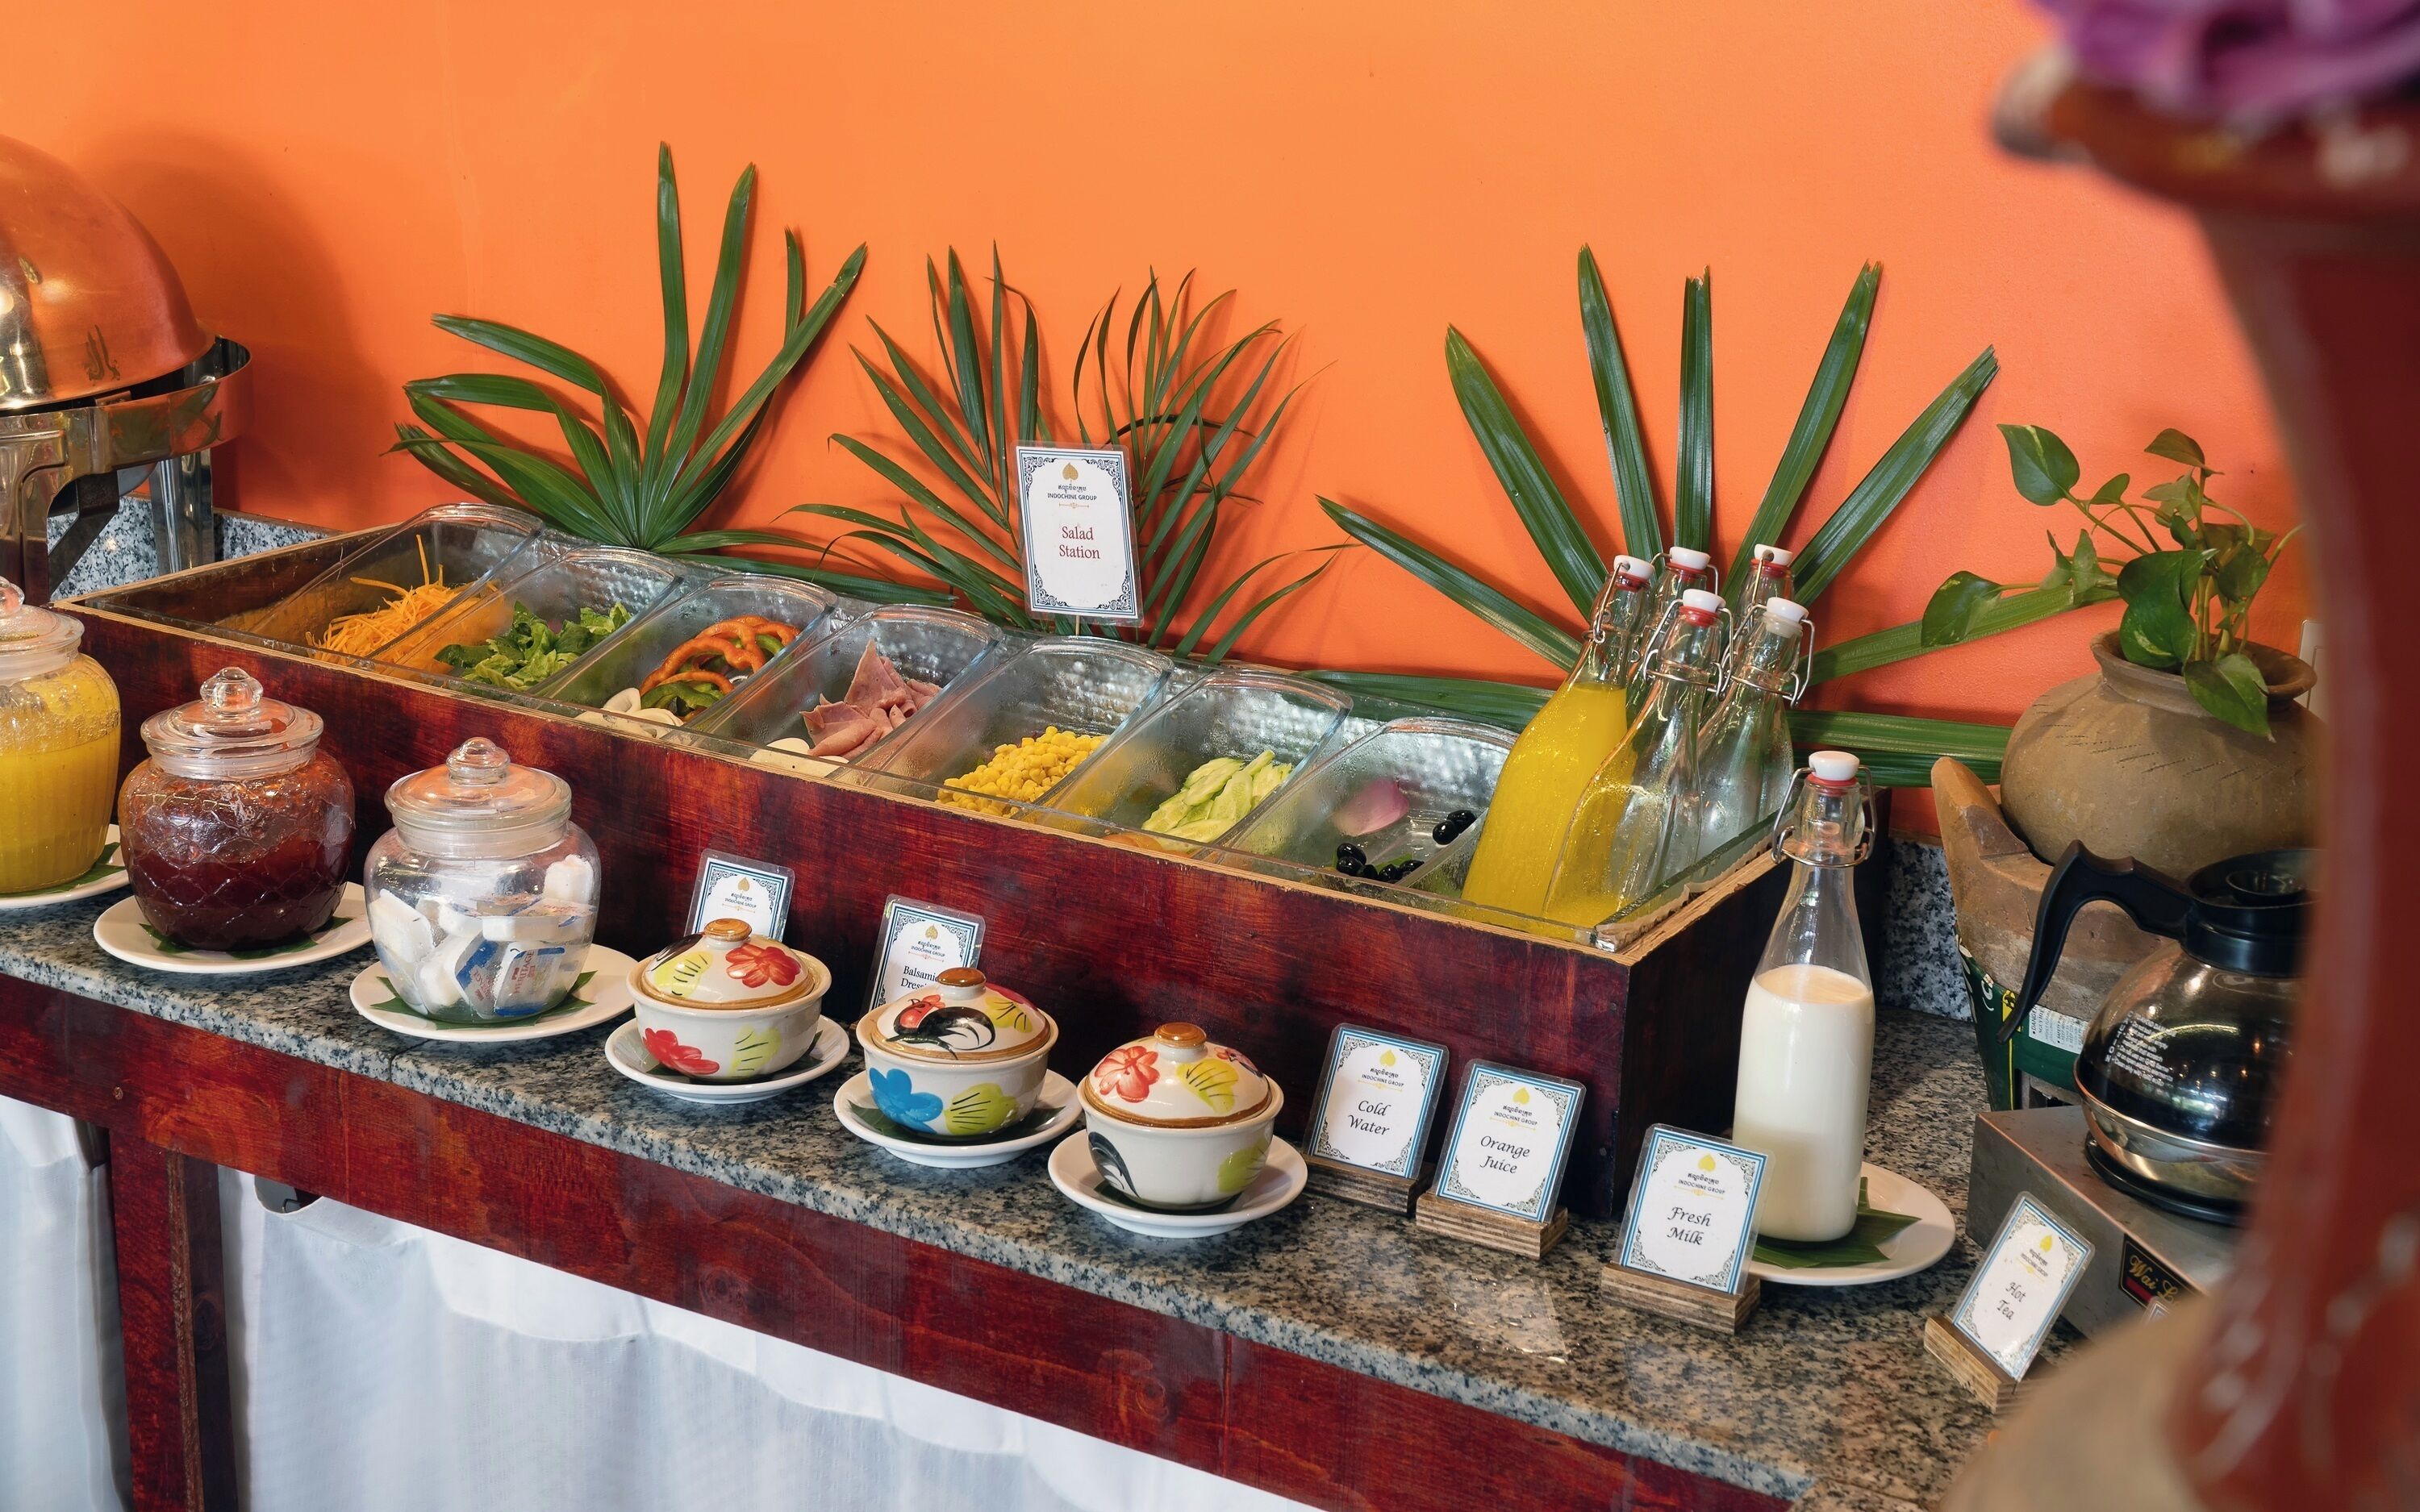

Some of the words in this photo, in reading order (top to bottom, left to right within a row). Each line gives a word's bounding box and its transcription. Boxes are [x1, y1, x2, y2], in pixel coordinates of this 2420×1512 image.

[1062, 526, 1094, 540] Salad
[1058, 544, 1100, 559] Station
[911, 945, 932, 954] INDOCHINE
[514, 950, 534, 993] HERITAGE
[2105, 1010, 2134, 1062] CAUTION
[1362, 1073, 1387, 1084] INDOCHINE
[1358, 1100, 1392, 1117] Cold
[1494, 1111, 1521, 1122] INDOCHINE
[1348, 1114, 1390, 1136] Water
[1480, 1135, 1530, 1159] Orange
[1480, 1155, 1517, 1174] Juice
[1679, 1179, 1706, 1190] INDOCHINE
[1708, 1186, 1725, 1194] GROUP
[1667, 1206, 1712, 1227] Fresh
[1667, 1227, 1704, 1246] Milk
[2130, 1255, 2155, 1289] Wai
[2005, 1281, 2026, 1302] Hot
[1996, 1300, 2014, 1320] Tea
